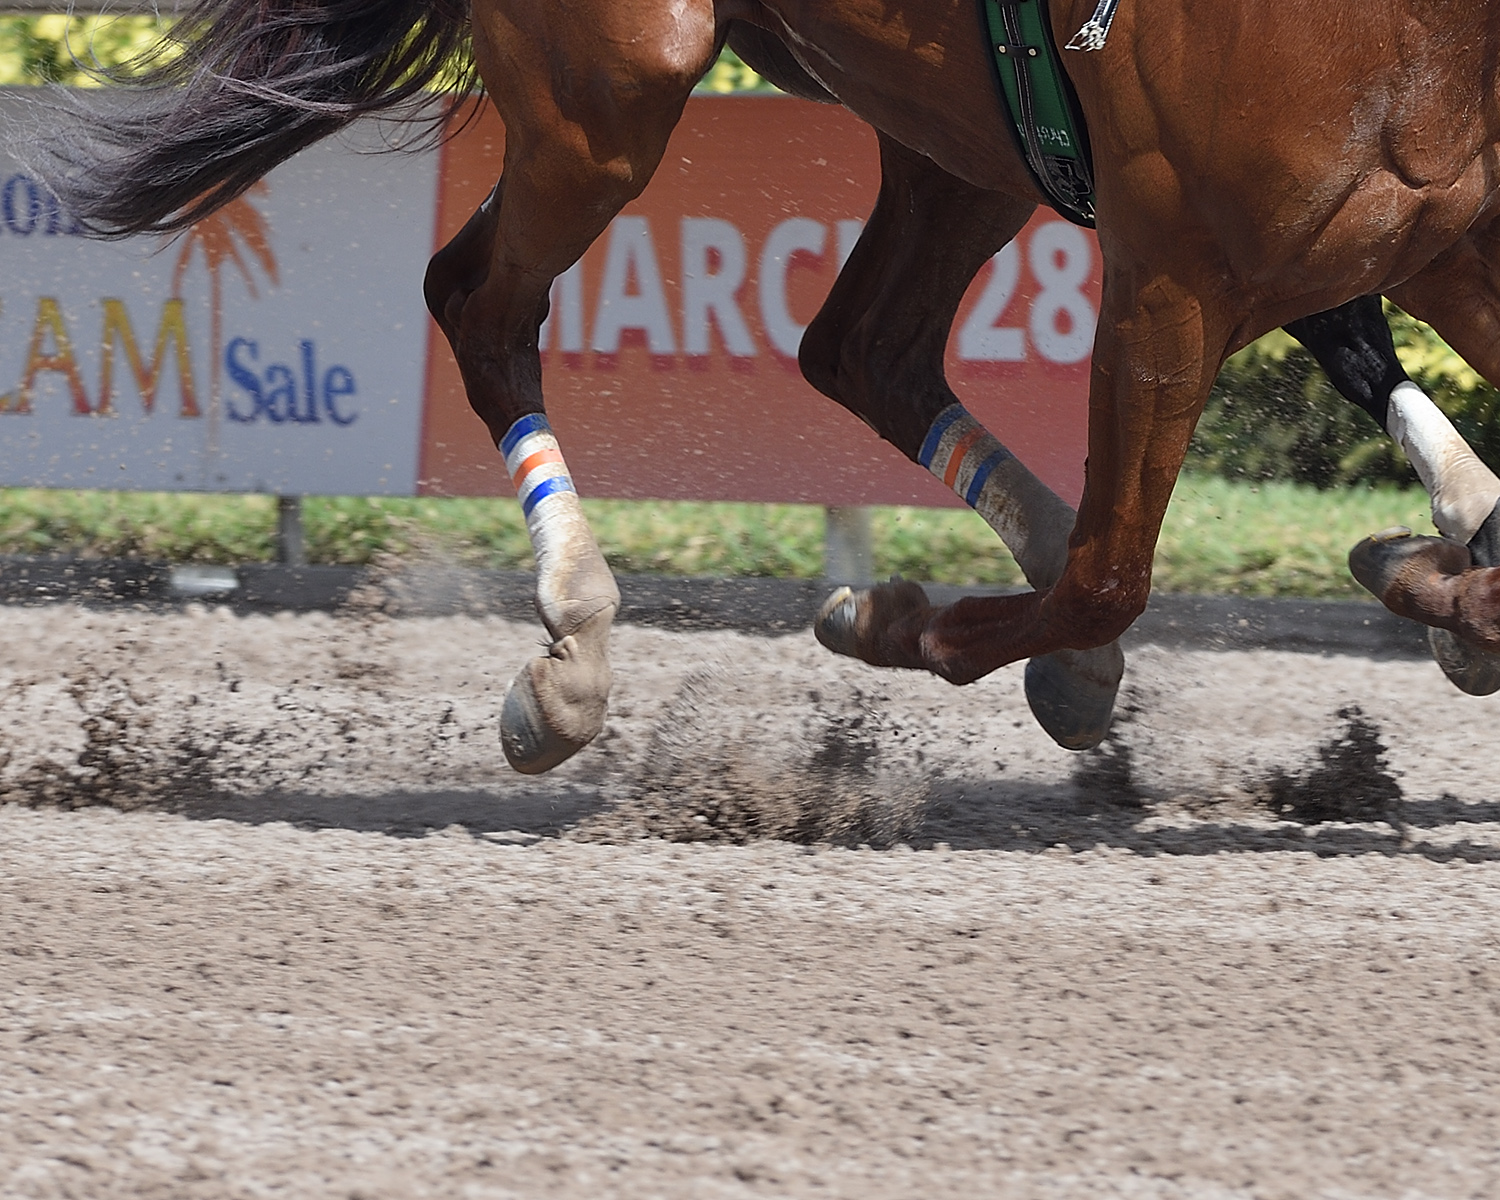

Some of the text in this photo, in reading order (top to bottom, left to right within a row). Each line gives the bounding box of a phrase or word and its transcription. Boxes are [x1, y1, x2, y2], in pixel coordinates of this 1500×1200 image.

[0, 296, 359, 427] AM Sale
[957, 220, 1096, 365] 28
